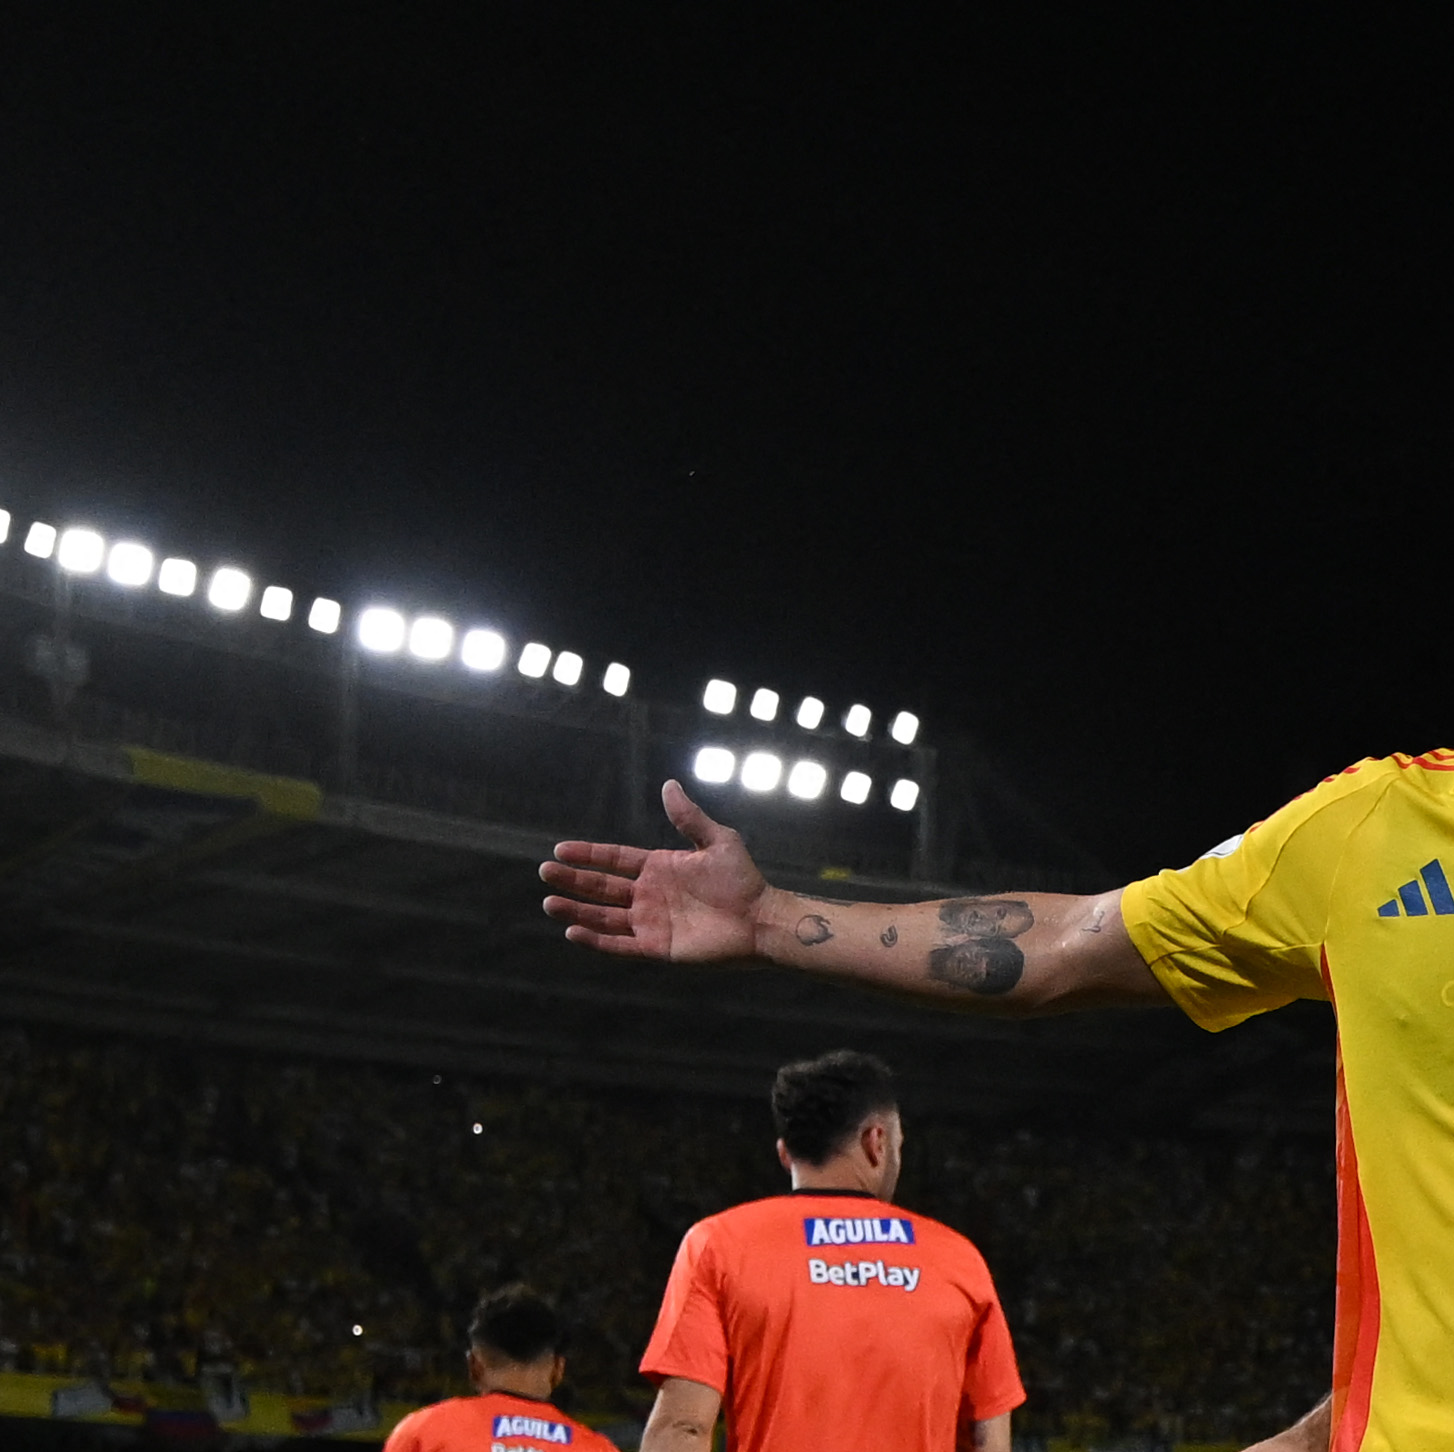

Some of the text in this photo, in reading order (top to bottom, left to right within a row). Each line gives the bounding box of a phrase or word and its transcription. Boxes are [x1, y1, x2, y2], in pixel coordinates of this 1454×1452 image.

[811, 1218, 909, 1245] AGUILA
[808, 1258, 920, 1291] BetPlay
[496, 1416, 568, 1443] AGUILA
